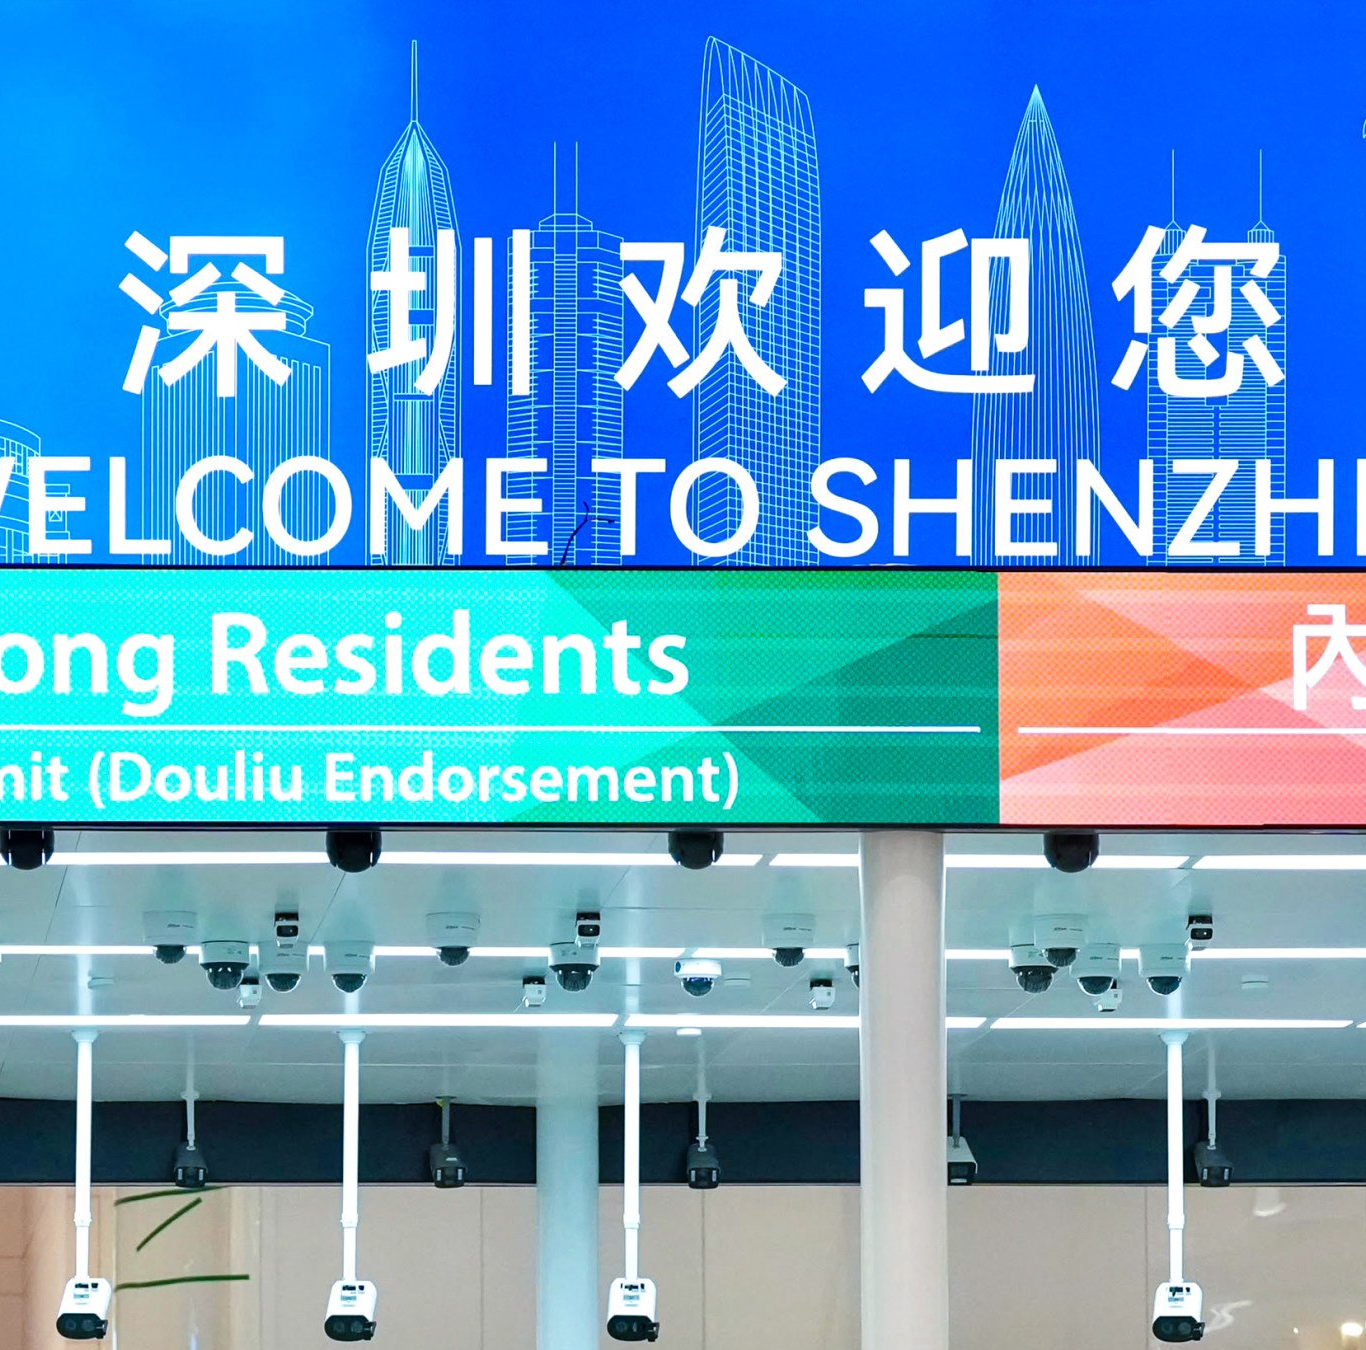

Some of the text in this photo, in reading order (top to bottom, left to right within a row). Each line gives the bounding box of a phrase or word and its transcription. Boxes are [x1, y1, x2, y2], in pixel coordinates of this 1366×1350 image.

[118, 225, 1286, 398] 深圳欢迎您
[591, 456, 760, 557] TO
[211, 609, 689, 695] Residents
[89, 751, 302, 809] (Douliu
[325, 751, 739, 810] Endorsement)
